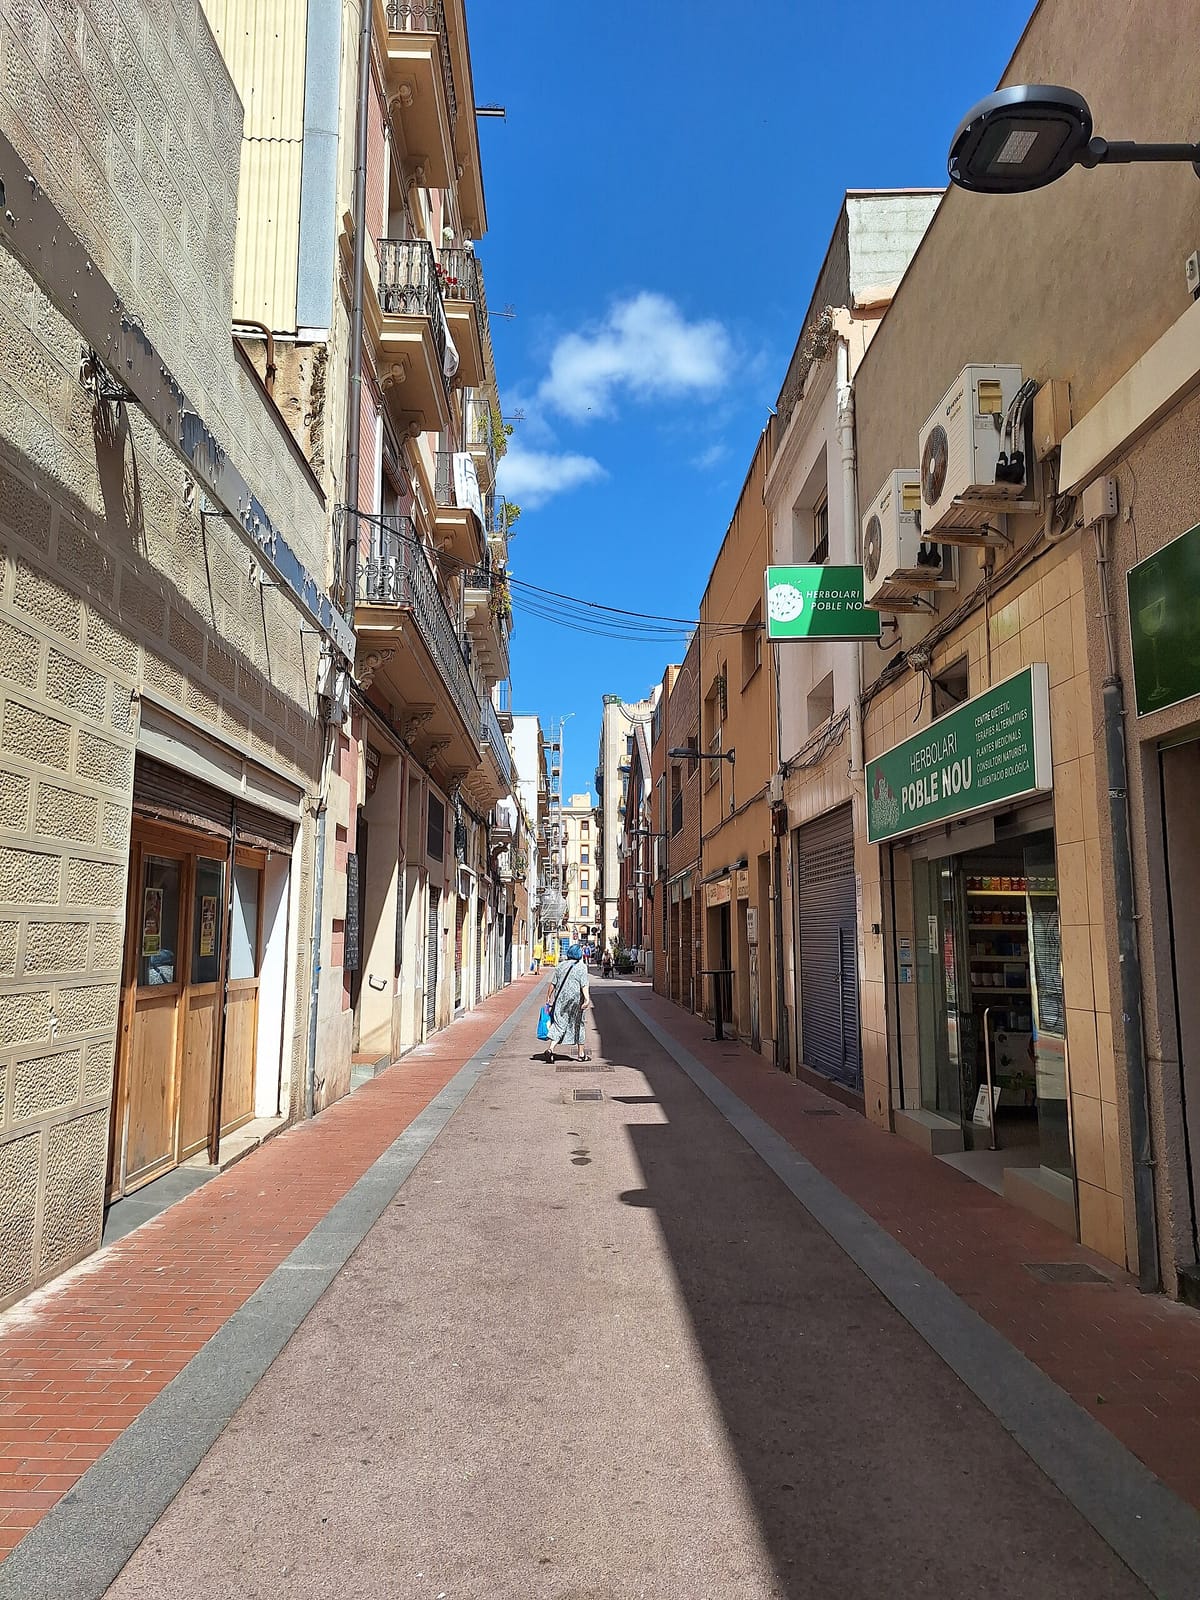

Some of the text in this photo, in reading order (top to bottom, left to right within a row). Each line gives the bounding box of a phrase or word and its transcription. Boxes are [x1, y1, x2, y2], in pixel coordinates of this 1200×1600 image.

[806, 590, 860, 599] HERBOLARI
[811, 602, 863, 611] POBLE NO
[975, 711, 991, 727] CENTRE
[995, 709, 1027, 732] ALTERNATIVES
[910, 732, 957, 774] HERBOLARI
[976, 729, 1021, 758] PLANTES MEDICINALS
[978, 744, 1027, 773] CONSULTORI NATURISTA
[902, 756, 972, 814] POBLE NOU
